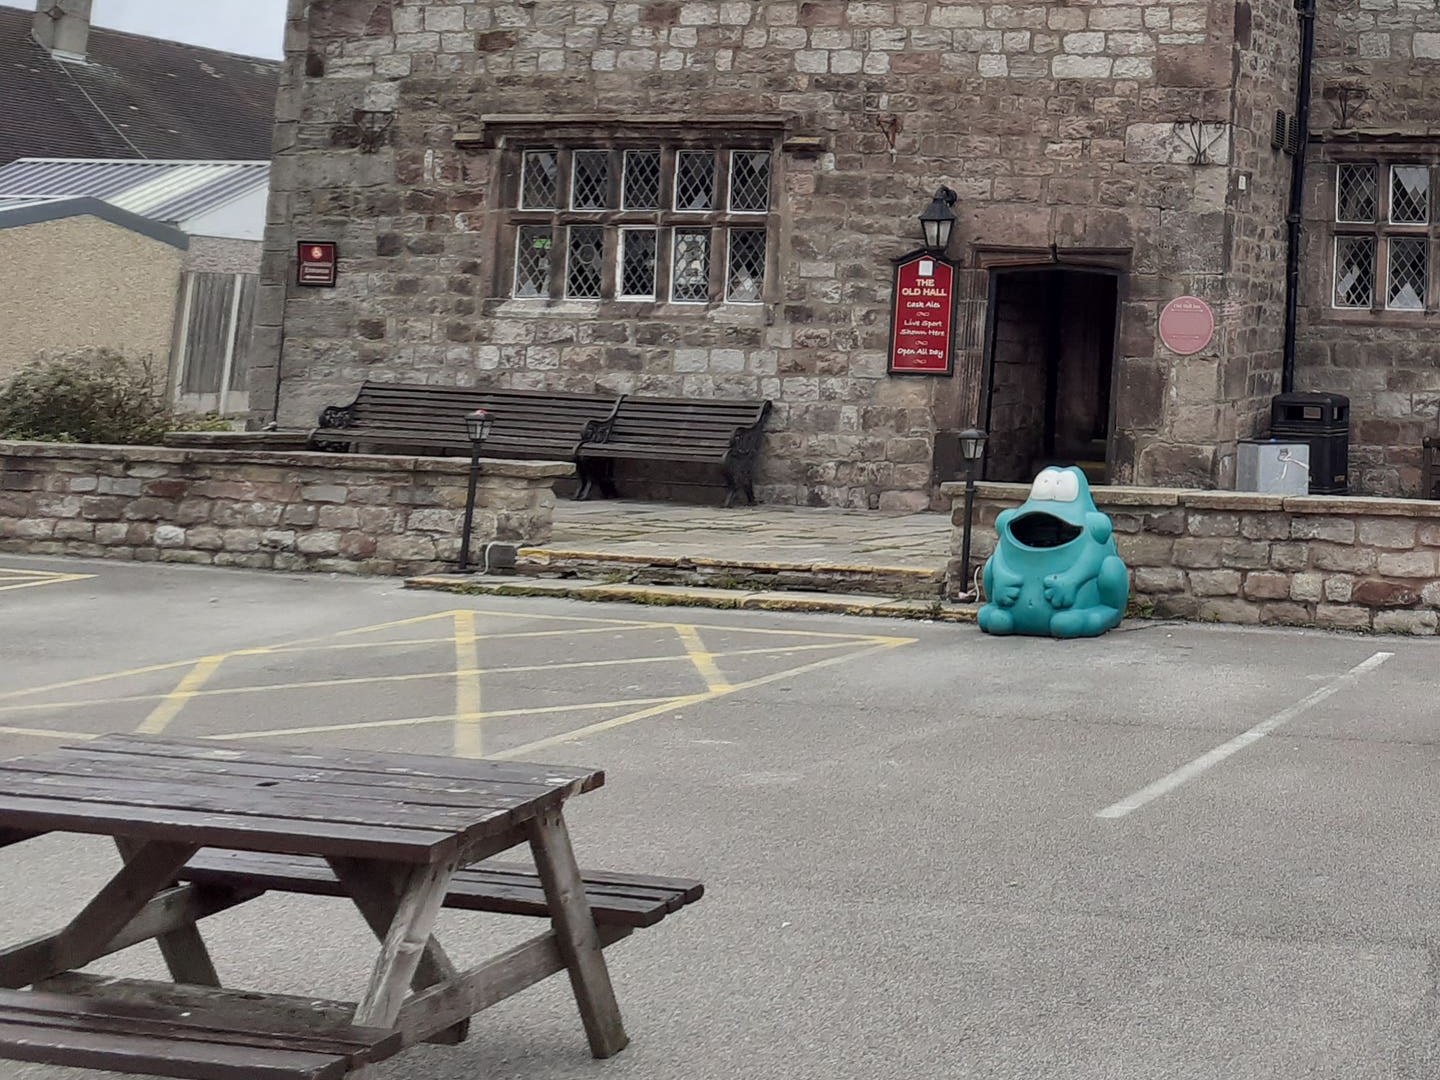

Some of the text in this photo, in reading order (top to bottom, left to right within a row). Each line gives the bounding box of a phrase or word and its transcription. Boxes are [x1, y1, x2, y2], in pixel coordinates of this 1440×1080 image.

[915, 278, 935, 287] THE
[901, 287, 948, 297] OLD HALL
[906, 300, 941, 309] Cask Ales
[921, 320, 943, 328] Sport
[896, 347, 916, 356] Open
[928, 349, 944, 359] Day
